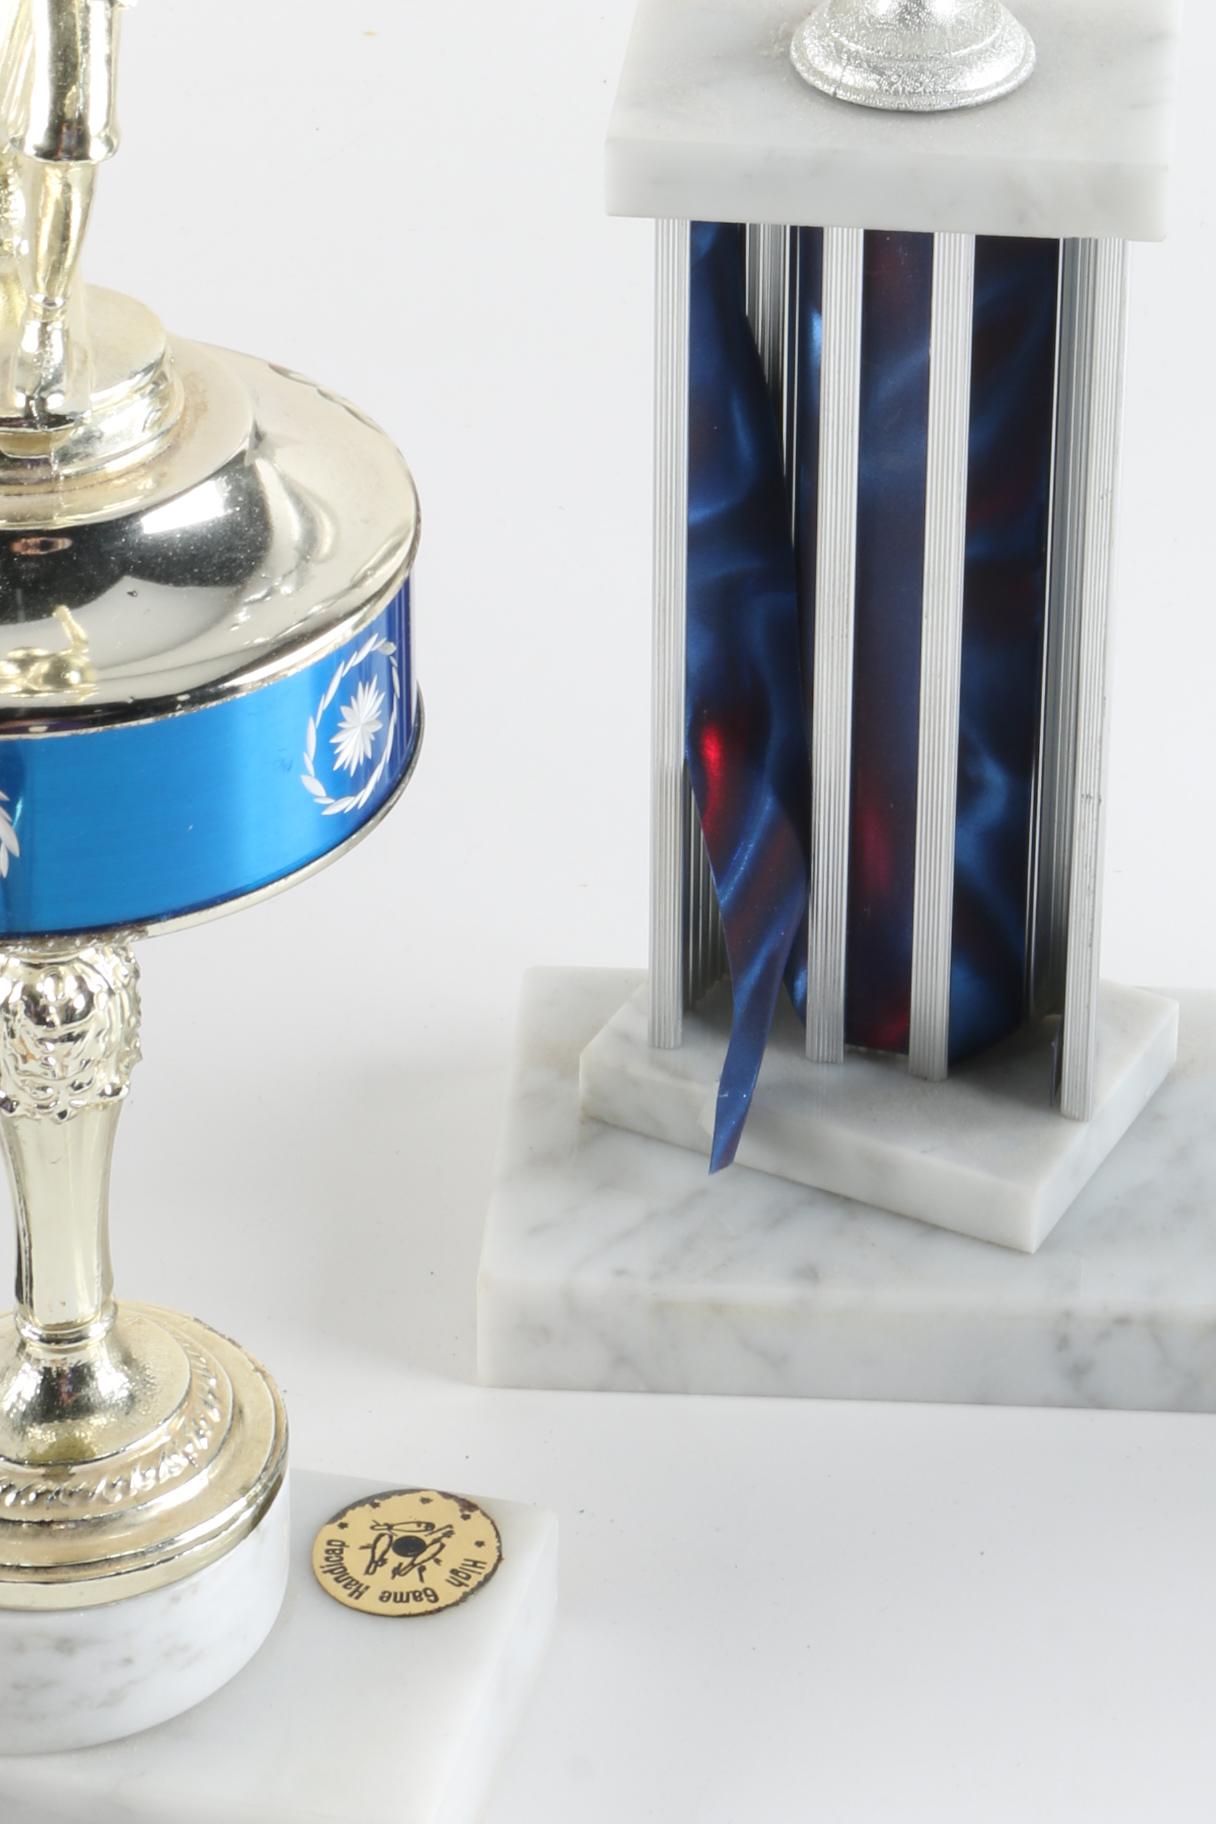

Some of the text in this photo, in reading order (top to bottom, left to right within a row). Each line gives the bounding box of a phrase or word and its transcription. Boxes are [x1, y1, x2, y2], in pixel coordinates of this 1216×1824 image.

[319, 1538, 487, 1605] High Game Handicap
